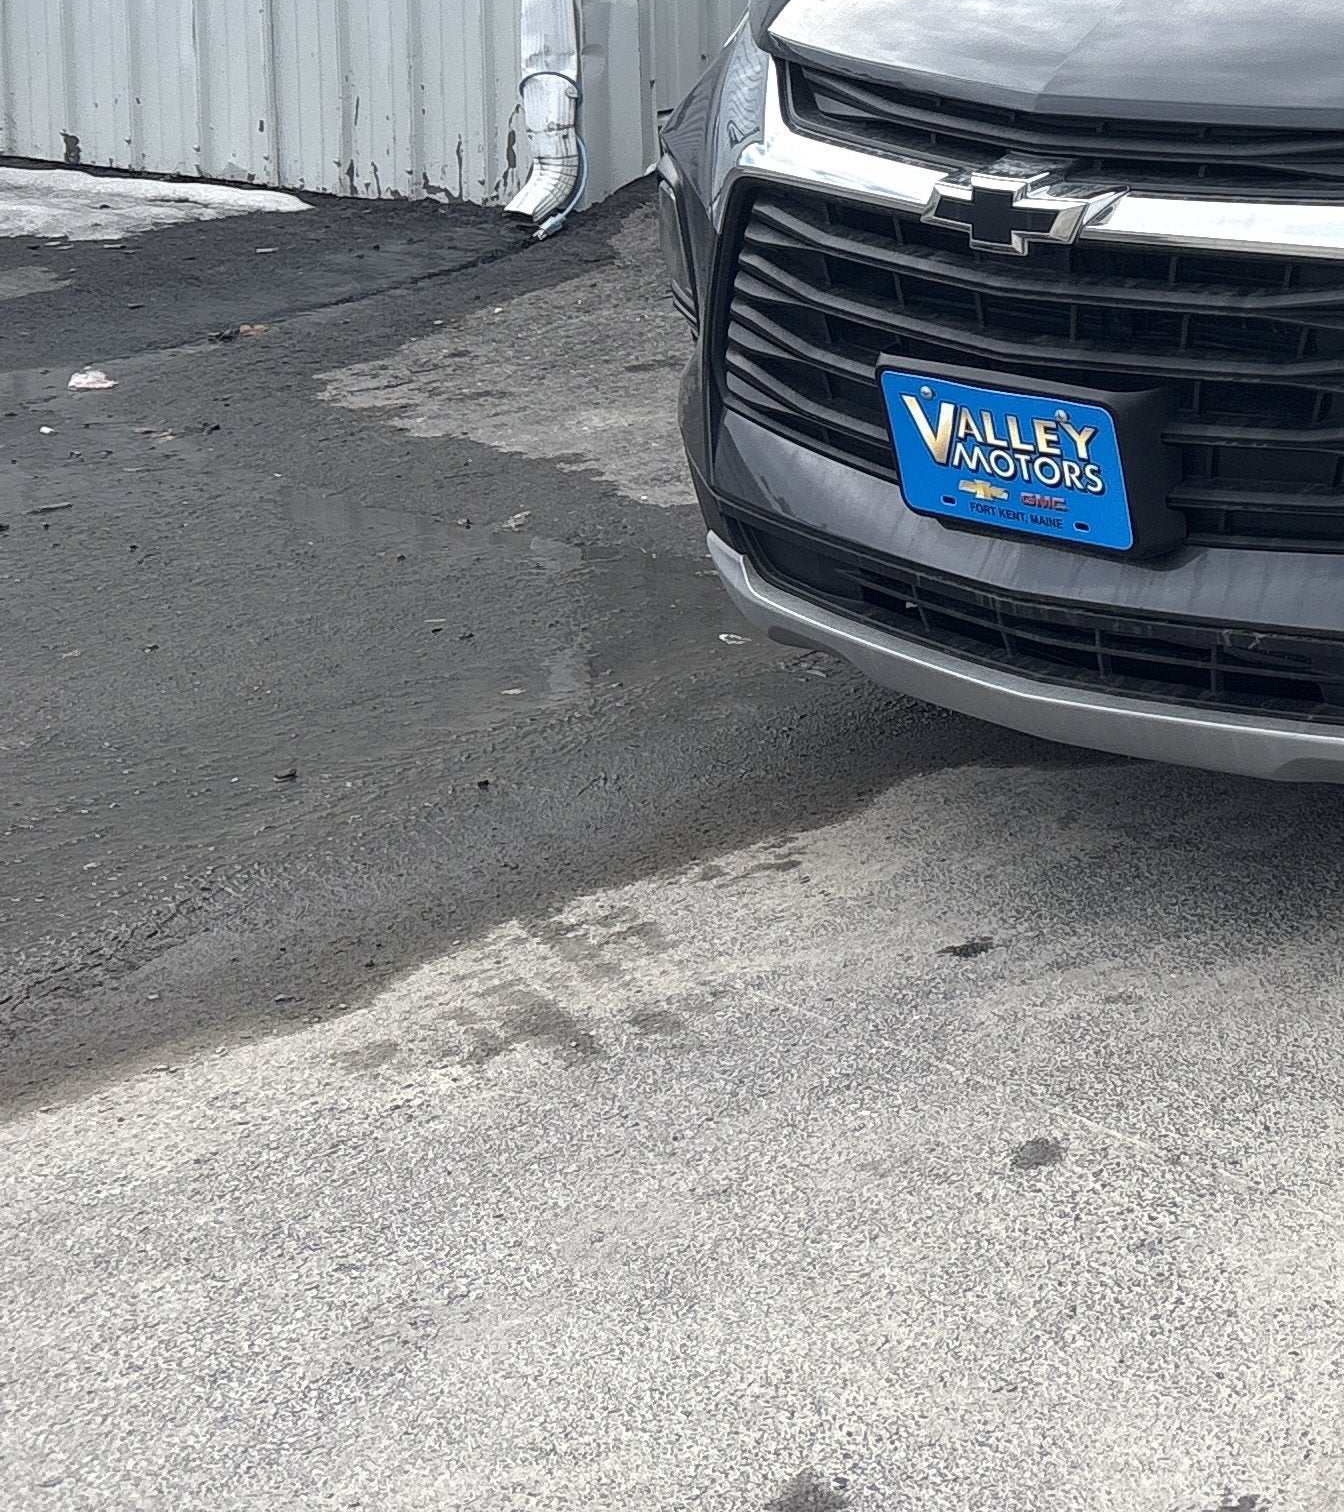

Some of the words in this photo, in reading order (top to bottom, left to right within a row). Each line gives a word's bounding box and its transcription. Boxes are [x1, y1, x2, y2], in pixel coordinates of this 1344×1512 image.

[900, 393, 1098, 465] VALLEY
[952, 442, 1104, 494] MOTORS
[969, 501, 997, 517] FORT
[1029, 513, 1064, 529] MAINE
[1020, 492, 1068, 512] GMC
